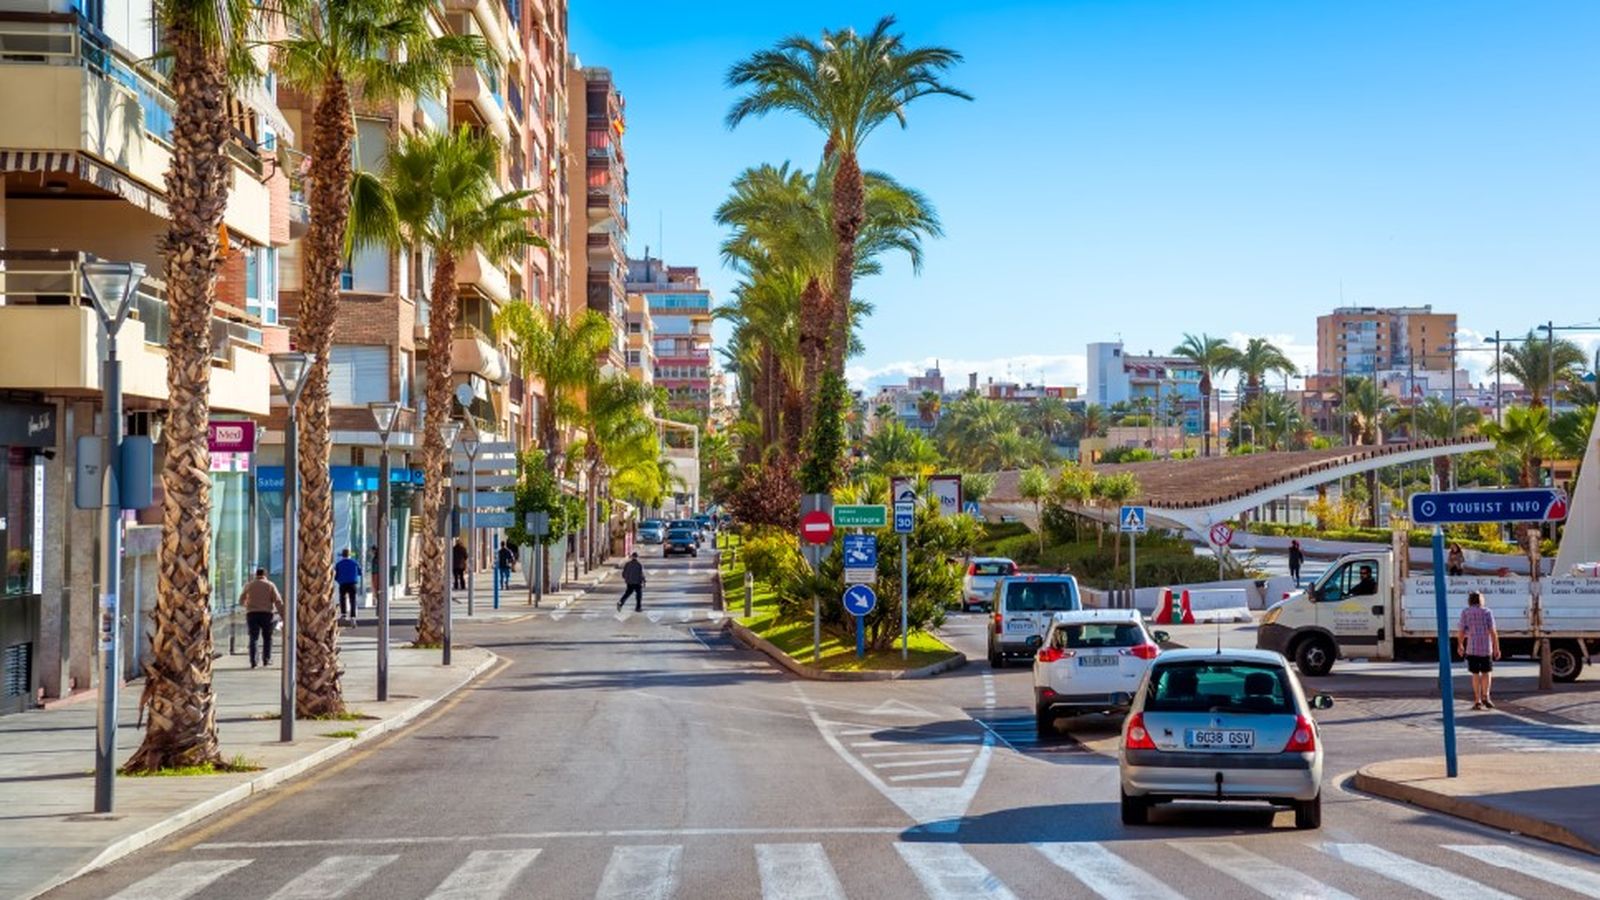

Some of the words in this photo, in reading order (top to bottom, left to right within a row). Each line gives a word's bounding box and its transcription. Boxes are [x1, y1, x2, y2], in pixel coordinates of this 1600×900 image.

[1448, 502, 1503, 514] TOURIST
[1510, 501, 1540, 513] INFO
[897, 518, 911, 527] 30
[1196, 731, 1224, 744] 6038
[1228, 731, 1250, 744] GSV
